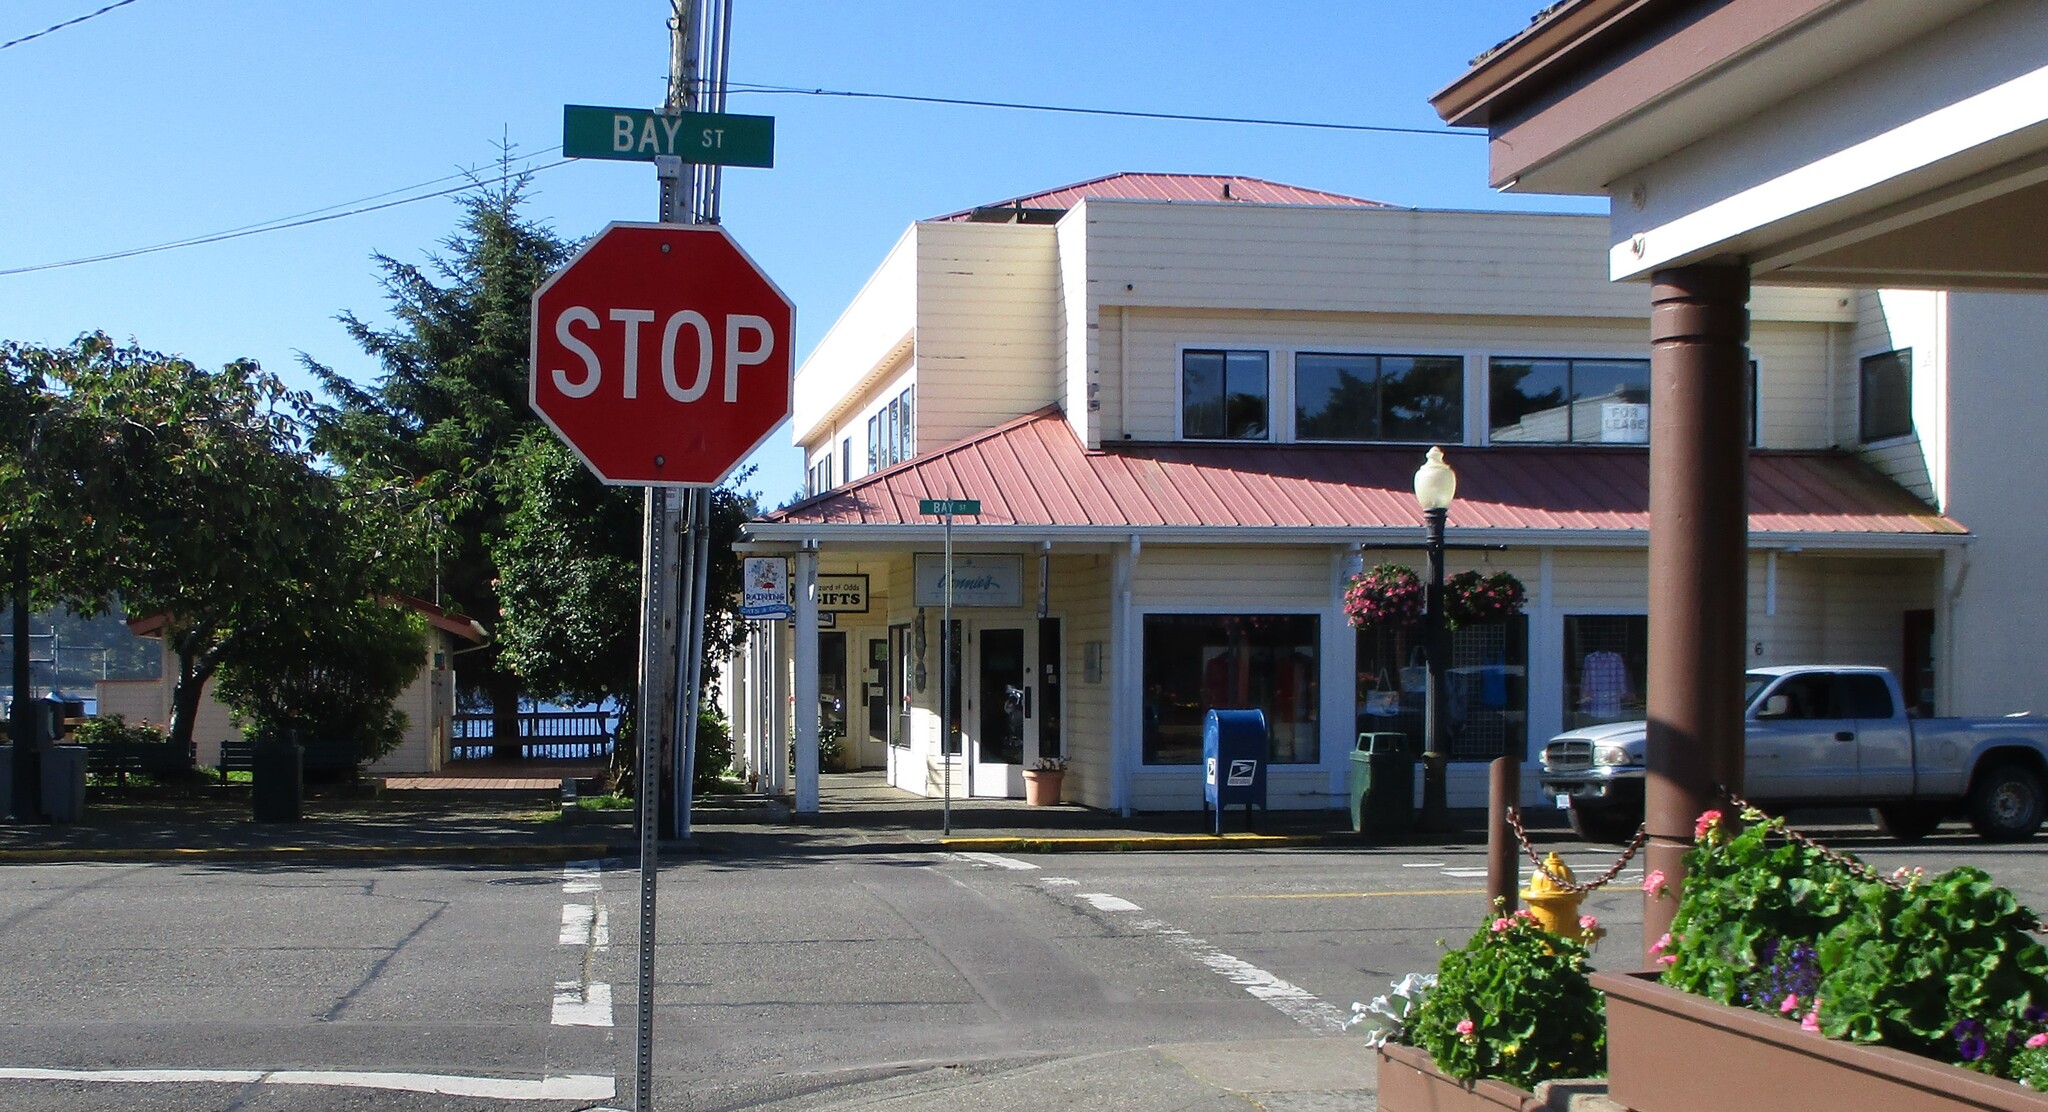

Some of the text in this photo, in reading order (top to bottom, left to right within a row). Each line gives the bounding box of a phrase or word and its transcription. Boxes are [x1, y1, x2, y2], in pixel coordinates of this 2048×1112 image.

[613, 114, 725, 154] BAY ST
[551, 305, 776, 404] STOP
[1611, 407, 1639, 419] FOR
[1604, 418, 1646, 430] LEASE
[933, 501, 954, 514] BAY
[843, 583, 860, 591] Odds
[745, 593, 785, 601] RAINING
